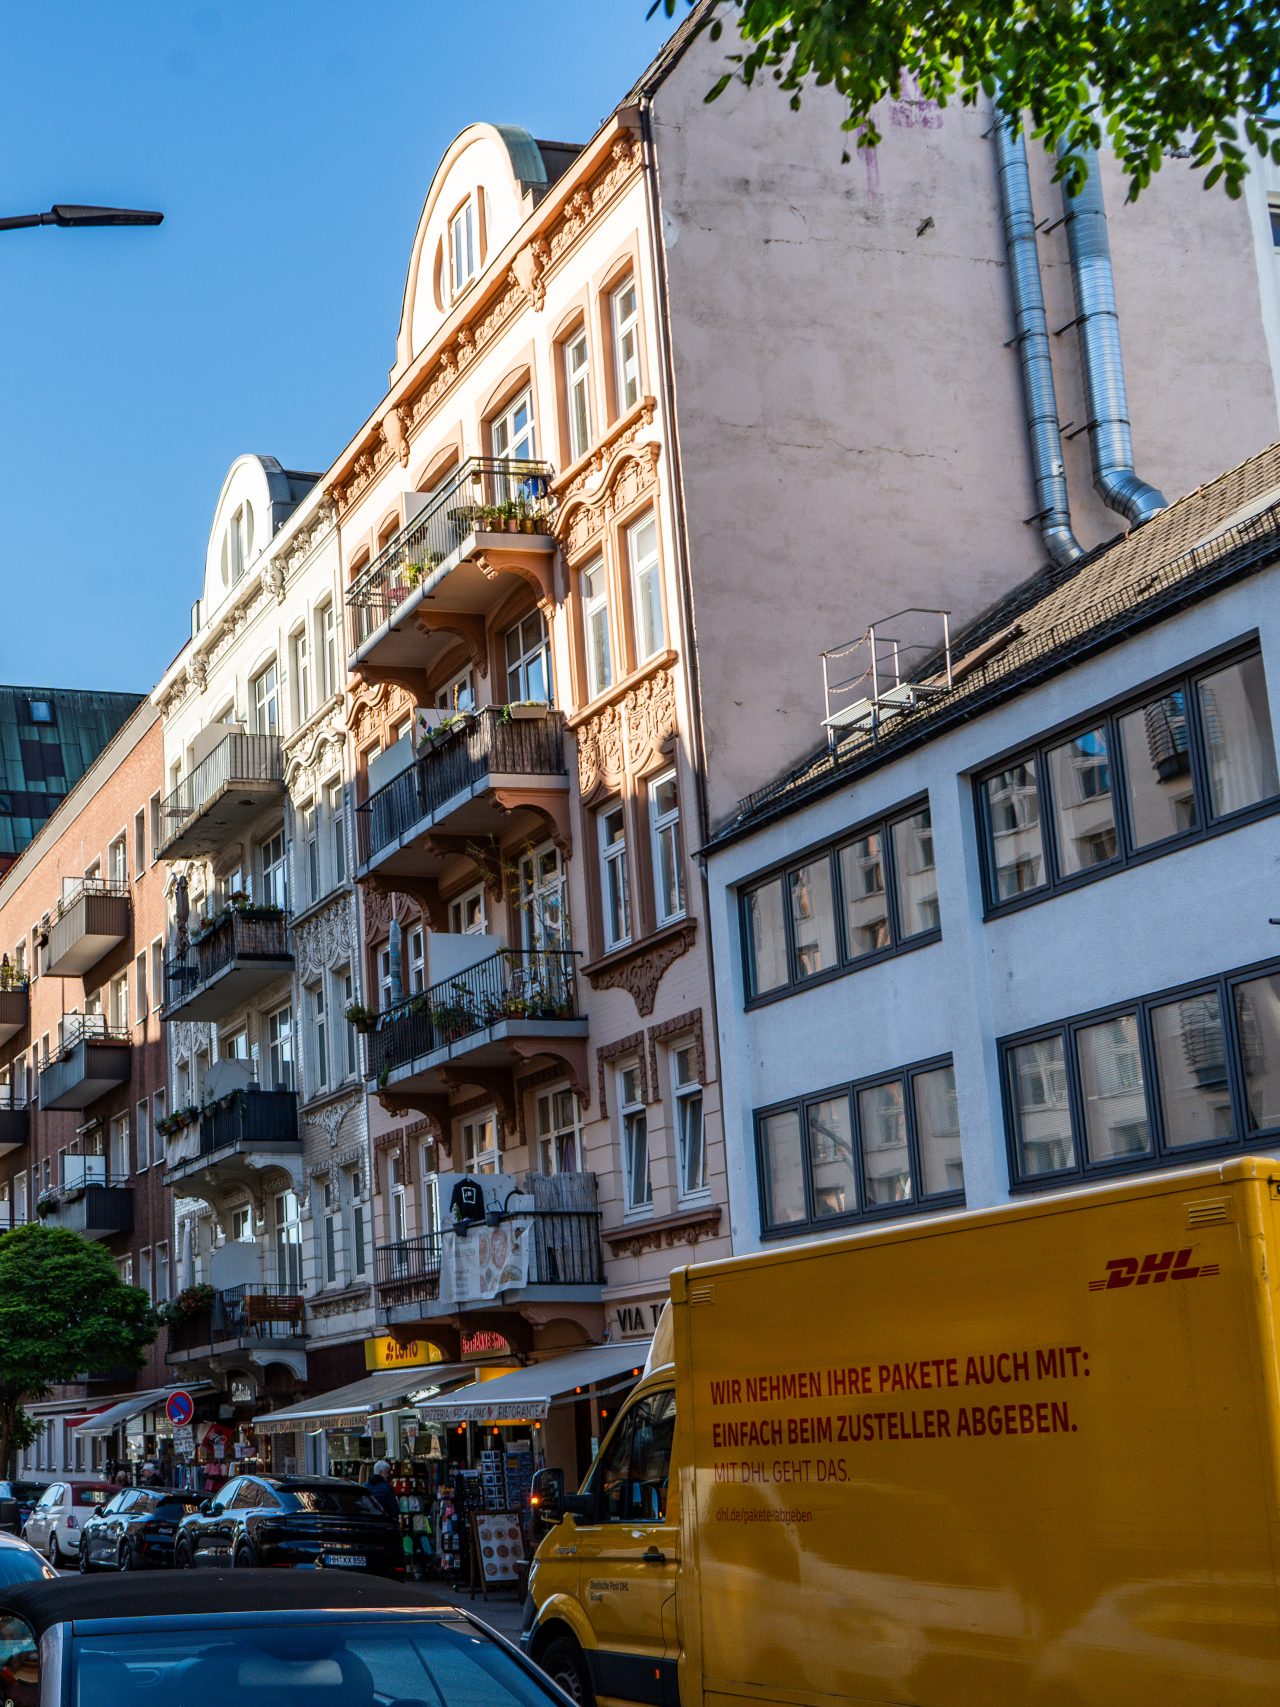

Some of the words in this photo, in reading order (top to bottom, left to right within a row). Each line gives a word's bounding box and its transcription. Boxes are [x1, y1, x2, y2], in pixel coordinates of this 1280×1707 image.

[1105, 1248, 1201, 1290] DHL
[616, 1306, 645, 1332] VIA
[710, 1379, 742, 1406] WIR
[746, 1371, 822, 1403] NEHMEN
[827, 1366, 873, 1397] IHRE
[878, 1358, 960, 1393] PAKETE
[964, 1351, 1031, 1386] AUCH
[1035, 1346, 1091, 1381] MIT:
[498, 1404, 540, 1418] RISTORANTE
[712, 1418, 783, 1448] EINFACH
[787, 1416, 833, 1445] BEIM
[837, 1408, 952, 1442] ZUSTELLER
[956, 1401, 1078, 1438] ABGEBEN.
[713, 1461, 739, 1484] MIT
[741, 1460, 770, 1484] DHL
[772, 1459, 812, 1483] GEHT
[816, 1458, 851, 1482] DAS.
[716, 1507, 813, 1526] dhl.de/pakete-abgeben
[590, 1580, 609, 1590] Deutsche
[610, 1580, 619, 1591] Post
[619, 1581, 629, 1592] DHL
